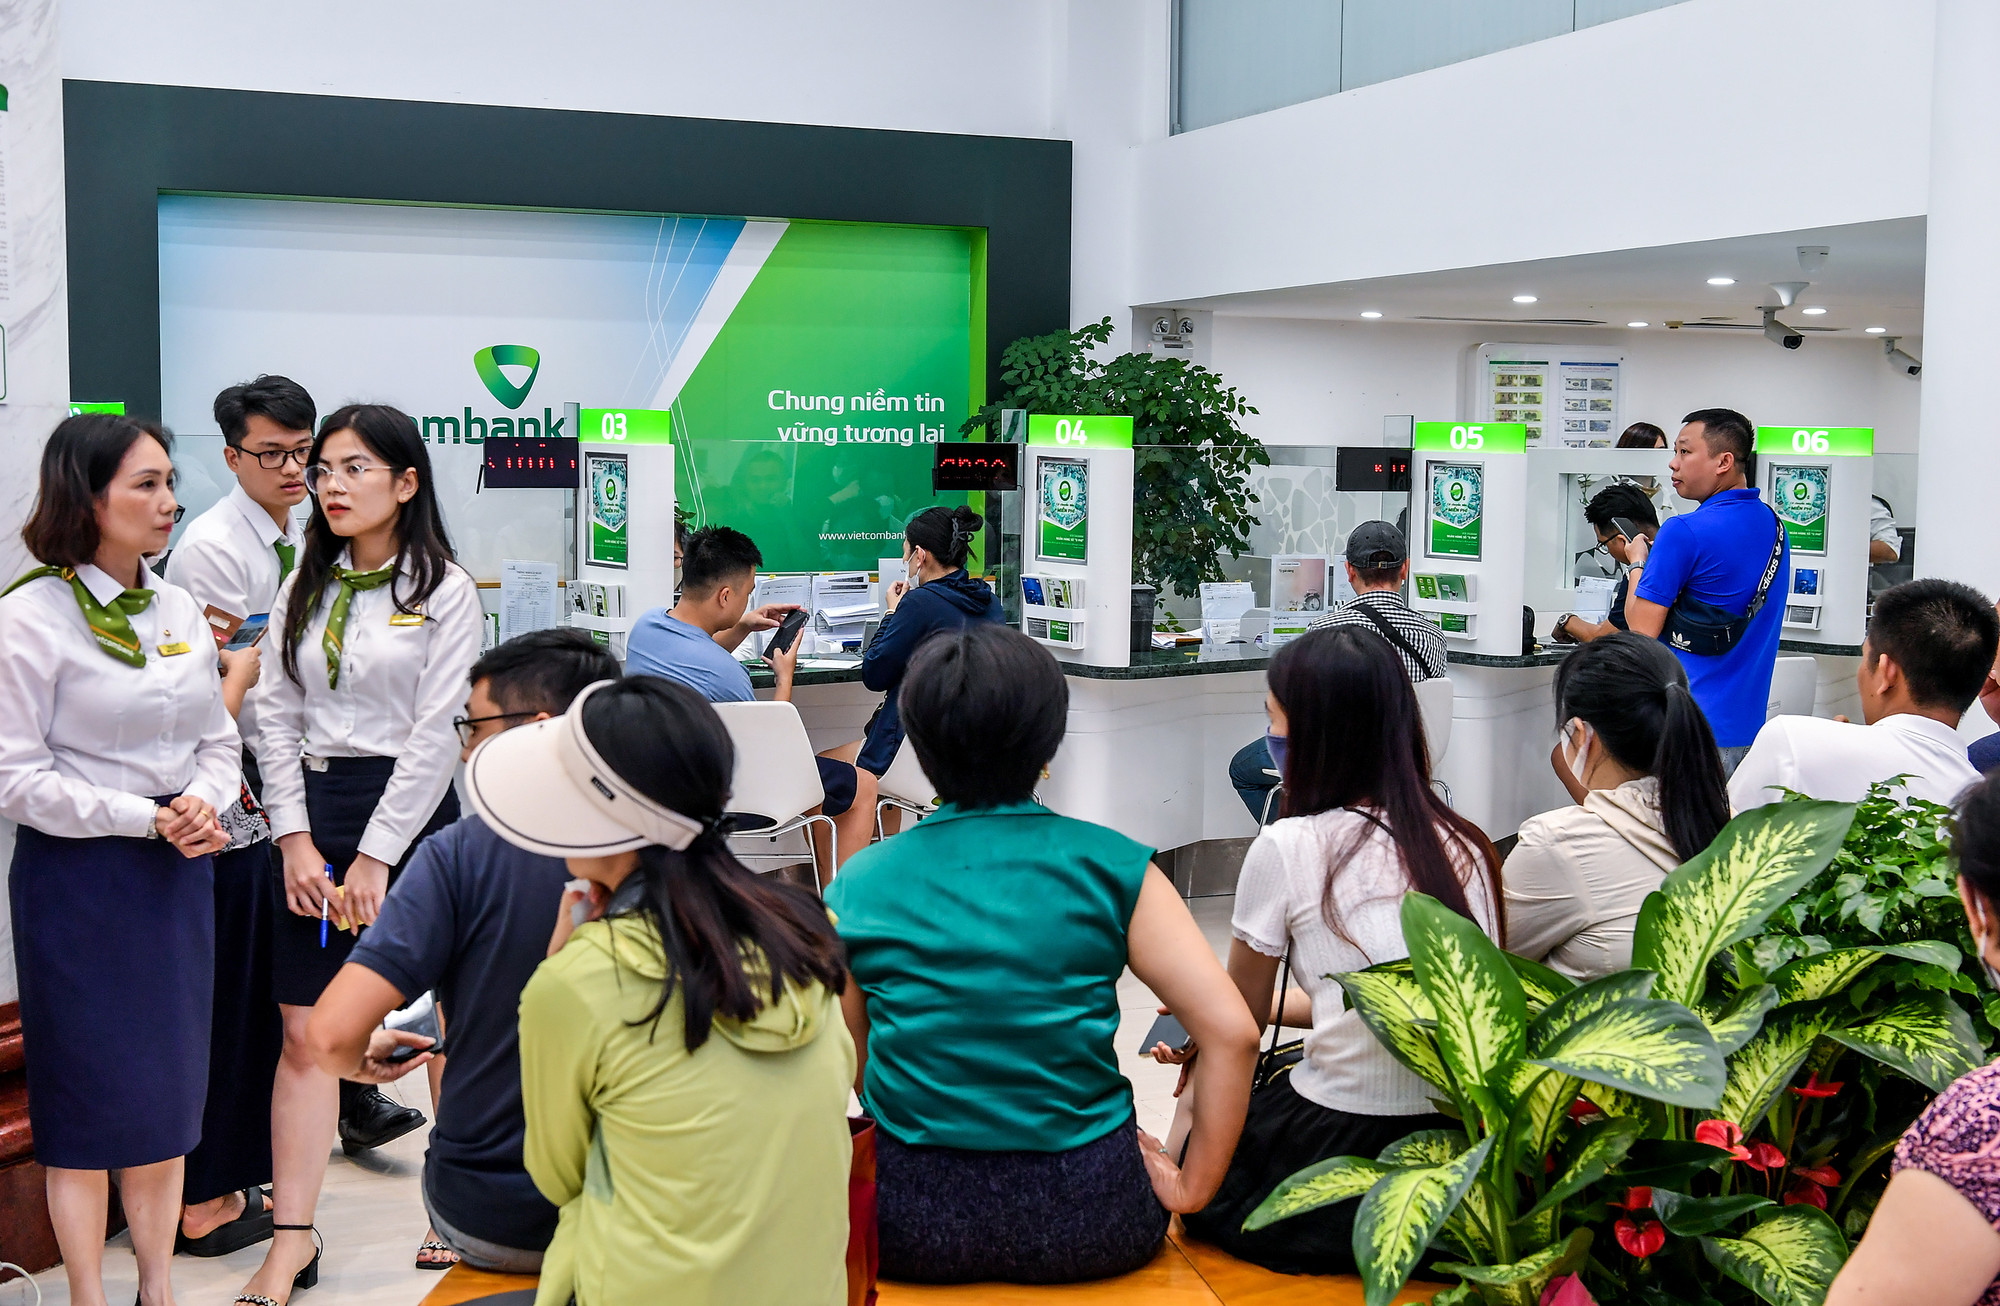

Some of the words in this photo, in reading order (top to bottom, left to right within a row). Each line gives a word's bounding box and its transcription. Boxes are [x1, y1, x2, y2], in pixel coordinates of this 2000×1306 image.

[768, 389, 844, 415] Chung
[850, 387, 909, 412] niềm
[914, 393, 945, 412] tin
[601, 412, 627, 440] 03
[777, 422, 838, 446] vững
[843, 424, 914, 447] tương
[1055, 419, 1088, 445] 04
[1449, 426, 1484, 450] 05
[1792, 430, 1829, 453] 06
